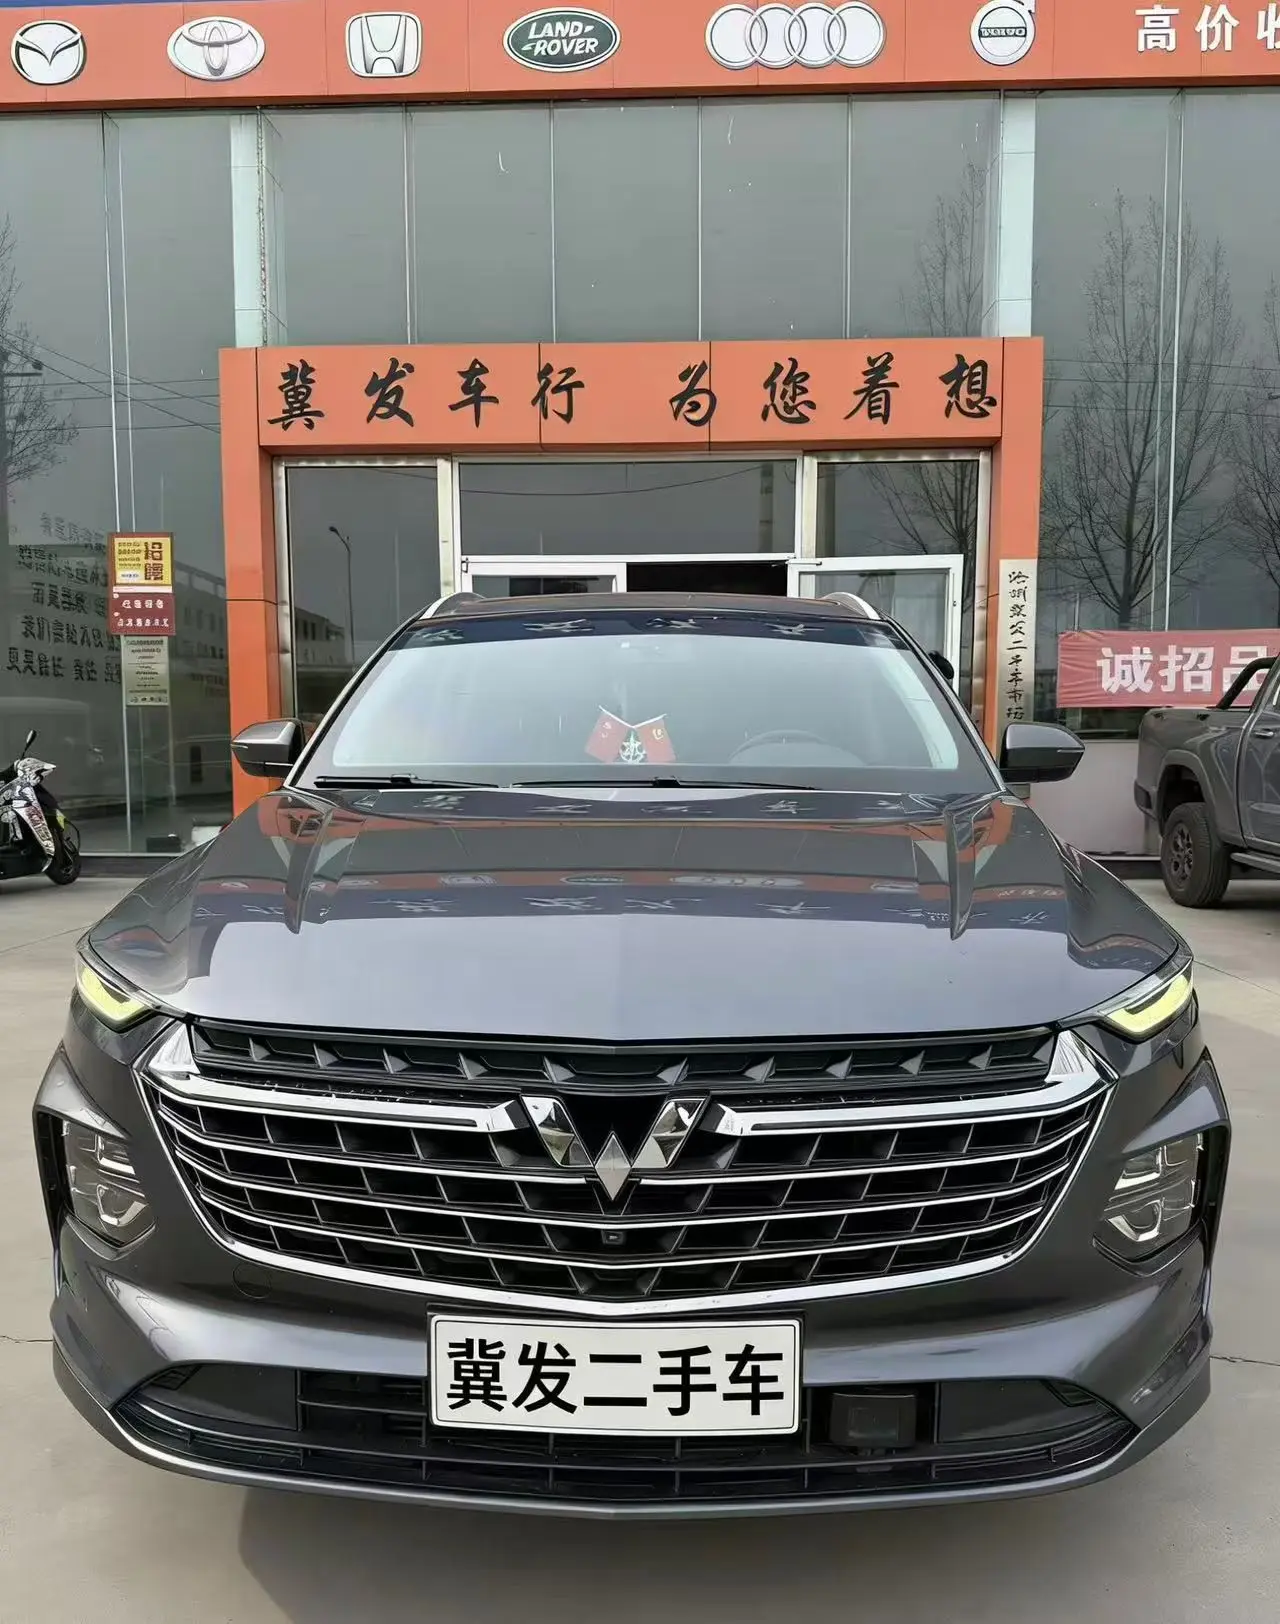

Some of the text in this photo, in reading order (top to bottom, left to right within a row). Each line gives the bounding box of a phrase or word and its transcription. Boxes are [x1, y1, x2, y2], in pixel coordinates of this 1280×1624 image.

[528, 21, 583, 39] LAND
[533, 38, 599, 56] ROVER
[267, 352, 998, 431] 冀发车行 为您着想
[446, 1337, 785, 1417] 冀发二手车
